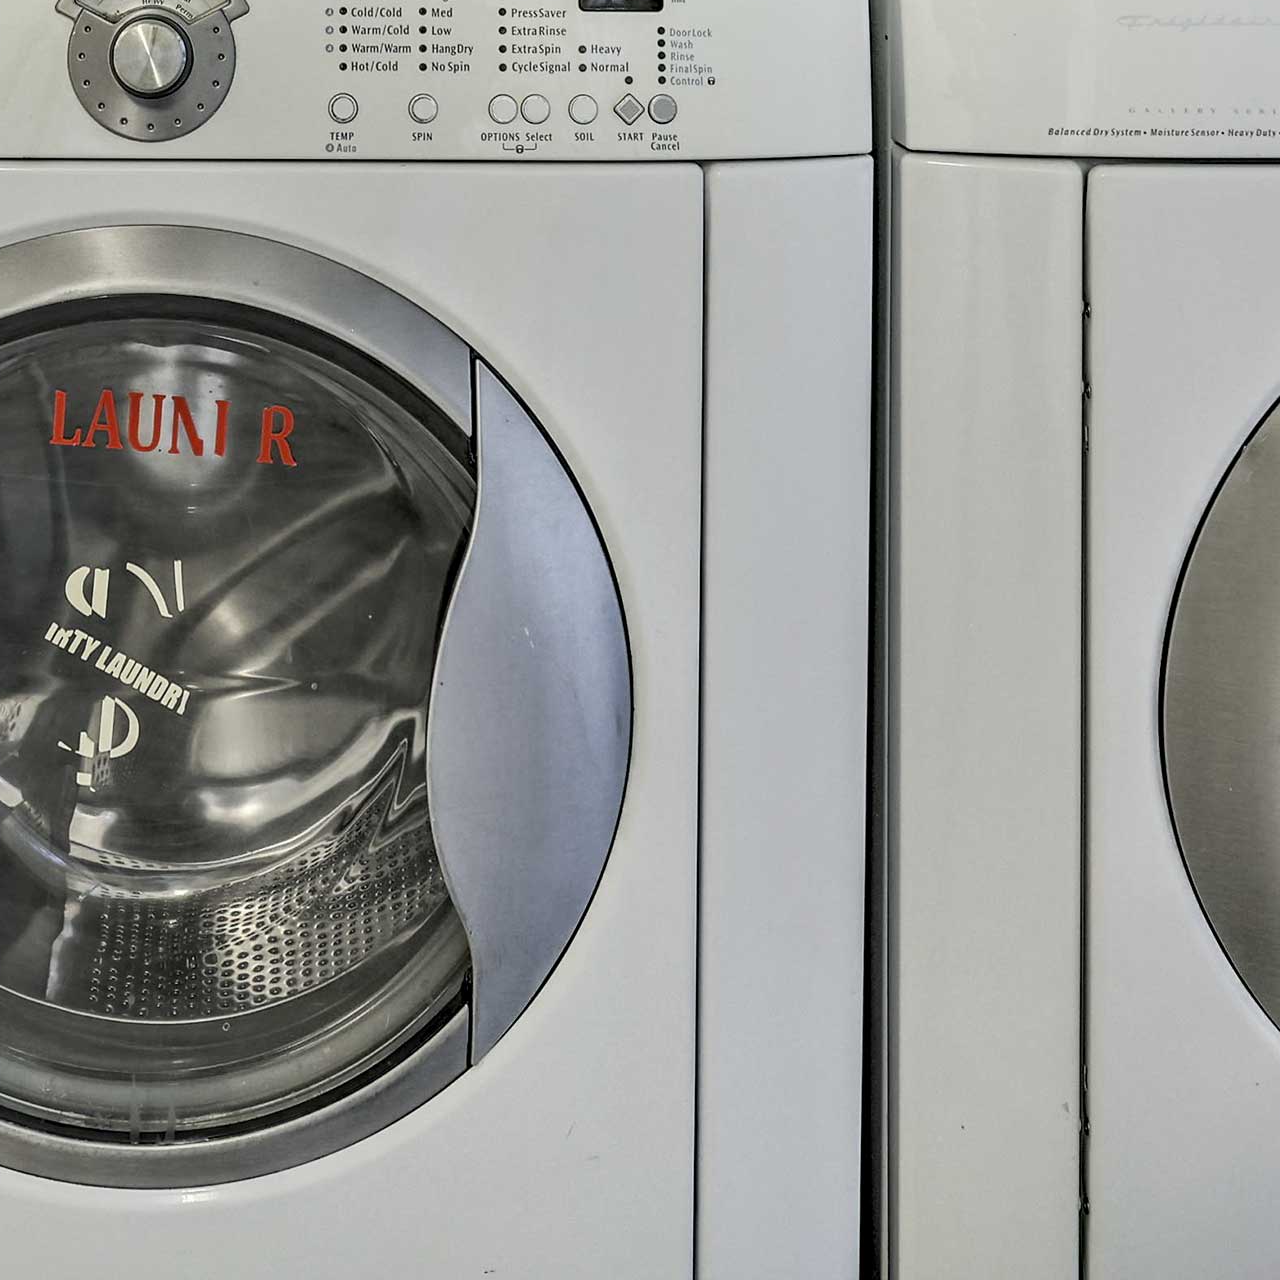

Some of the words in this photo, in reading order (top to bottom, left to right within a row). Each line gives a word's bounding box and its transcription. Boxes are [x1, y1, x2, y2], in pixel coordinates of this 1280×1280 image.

[351, 7, 402, 18] Cold/Cold
[431, 7, 453, 18] Med
[351, 25, 410, 36] Warm/Cold
[431, 25, 452, 36] Low
[351, 43, 412, 54] Warm/Warm
[670, 40, 694, 49] Wash
[590, 44, 621, 57] Heavy
[670, 52, 695, 61] Rinse
[351, 61, 399, 72] Hot/Cold
[431, 61, 445, 71] No
[448, 61, 470, 74] Spin
[590, 61, 629, 72] Normal
[670, 76, 704, 86] Control
[330, 132, 355, 142] TEMP
[411, 132, 433, 142] SPIN
[480, 132, 520, 142] OPTIONS
[525, 132, 553, 142] Select
[574, 132, 595, 142] SOIL
[617, 132, 644, 142] START
[651, 132, 678, 142] Pause
[1048, 127, 1091, 137] Balanced
[1093, 127, 1109, 138] Dry
[1110, 128, 1142, 138] System
[1150, 128, 1189, 137] Moisture
[1190, 128, 1219, 137] Sensor
[1228, 128, 1254, 138] Heavy
[1255, 128, 1277, 138] Duty
[336, 143, 357, 154] Auto
[650, 142, 680, 152] Cancel
